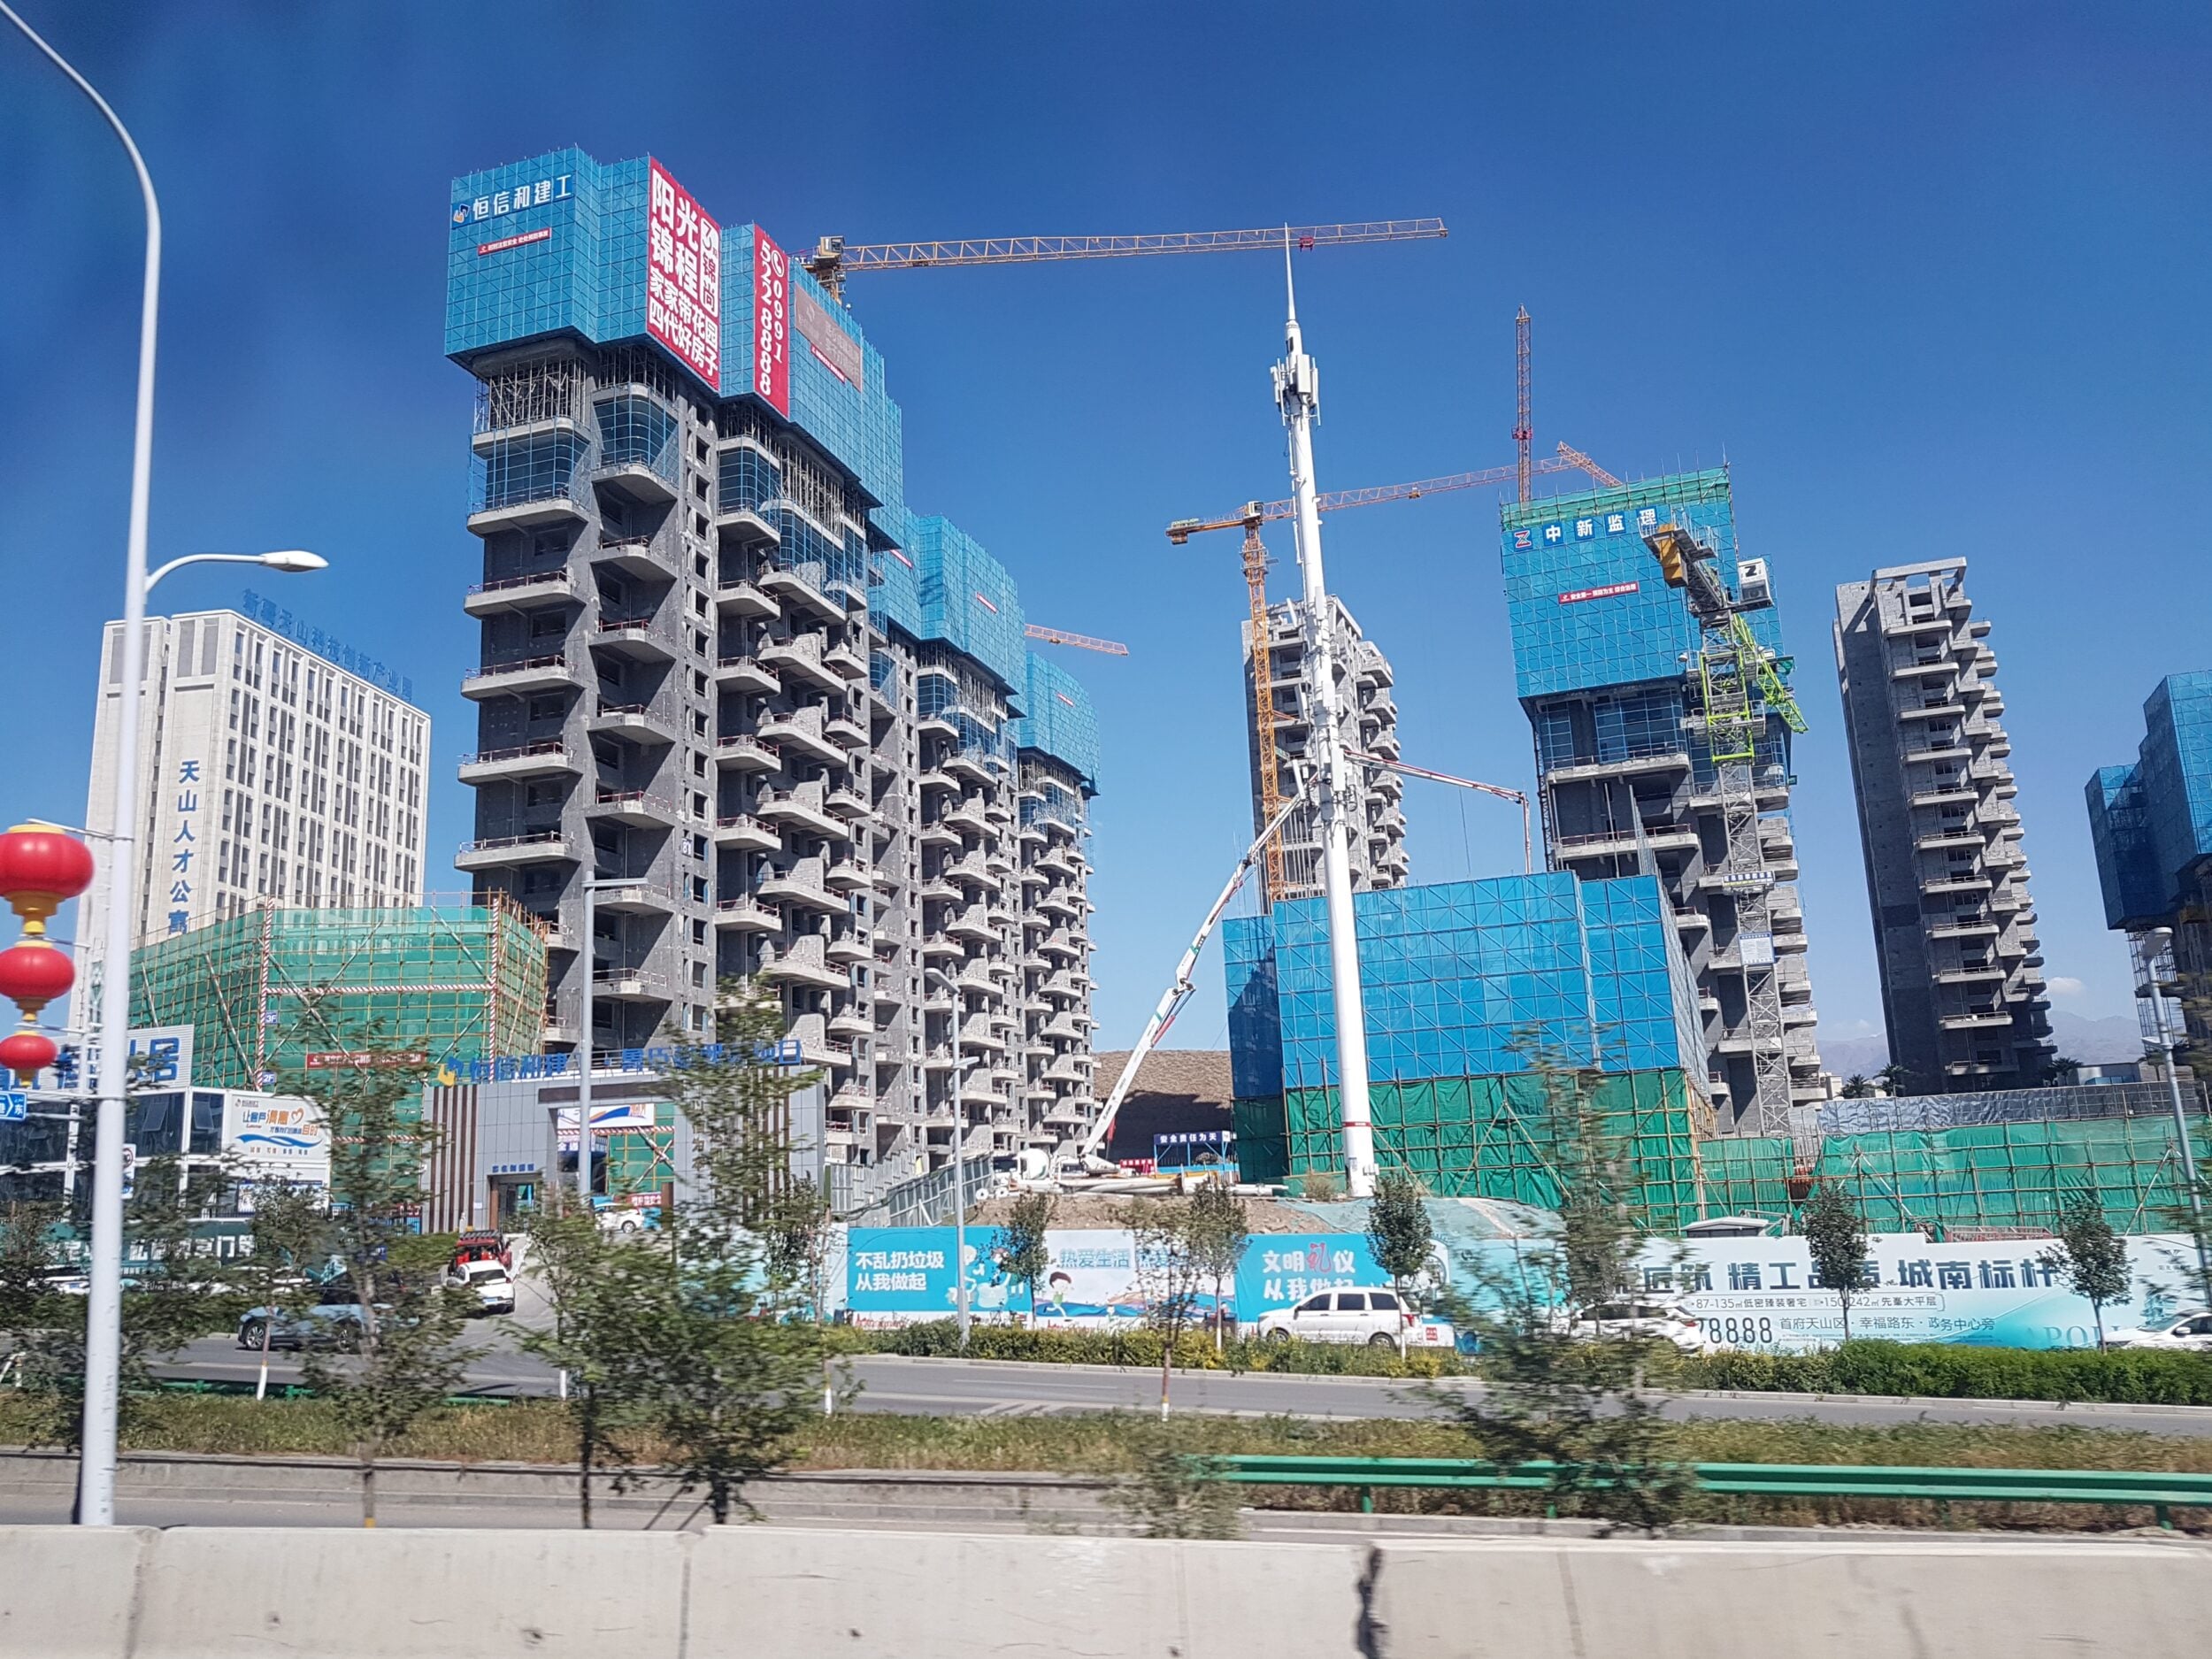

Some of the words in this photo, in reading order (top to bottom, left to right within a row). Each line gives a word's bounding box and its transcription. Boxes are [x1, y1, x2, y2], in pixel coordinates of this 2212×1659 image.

[472, 174, 572, 221] 恒信和建工
[649, 265, 718, 353] 家家带花园
[649, 295, 718, 377] 四代好房子
[1546, 508, 1658, 542] 中新监理
[166, 759, 201, 936] 天山人才公寓
[265, 1012, 277, 1023] 3F
[264, 1072, 275, 1083] 2F
[1159, 1133, 1217, 1144] 安全责任为天
[855, 1249, 945, 1271] 不乱扔垃圾
[1060, 1248, 1130, 1268] 热爱生活
[1262, 1242, 1356, 1274] 文明礼仪
[1897, 1257, 2057, 1290] 城南标杆
[855, 1272, 927, 1292] 从我做起
